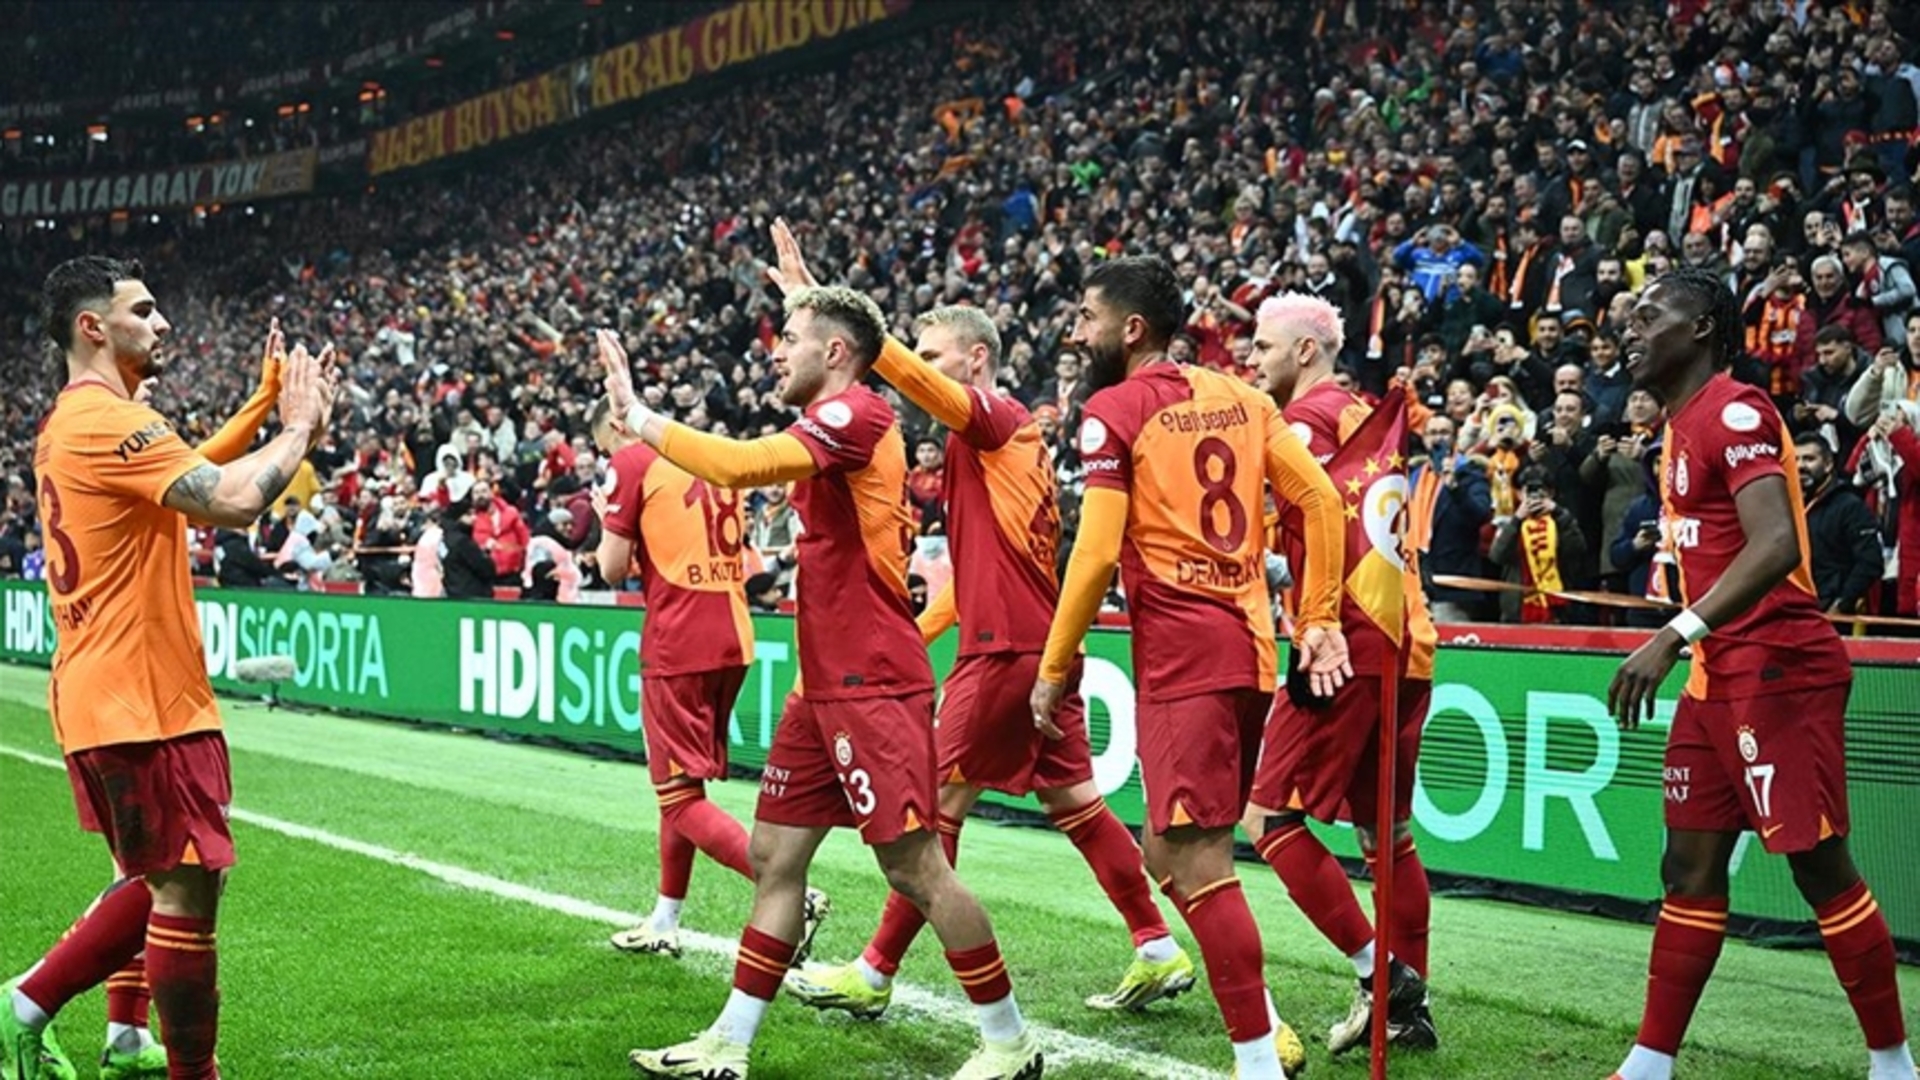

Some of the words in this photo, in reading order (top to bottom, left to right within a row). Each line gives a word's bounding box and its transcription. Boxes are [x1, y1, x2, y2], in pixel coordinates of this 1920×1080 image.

[591, 26, 692, 109] KRAL
[2, 168, 202, 216] GALATASARAY
[211, 160, 266, 197] YOK!
[683, 477, 742, 558] 18
[1194, 437, 1247, 553] 8
[5, 589, 43, 654] HDI
[459, 617, 555, 723] HDI
[1744, 764, 1775, 817] 17
